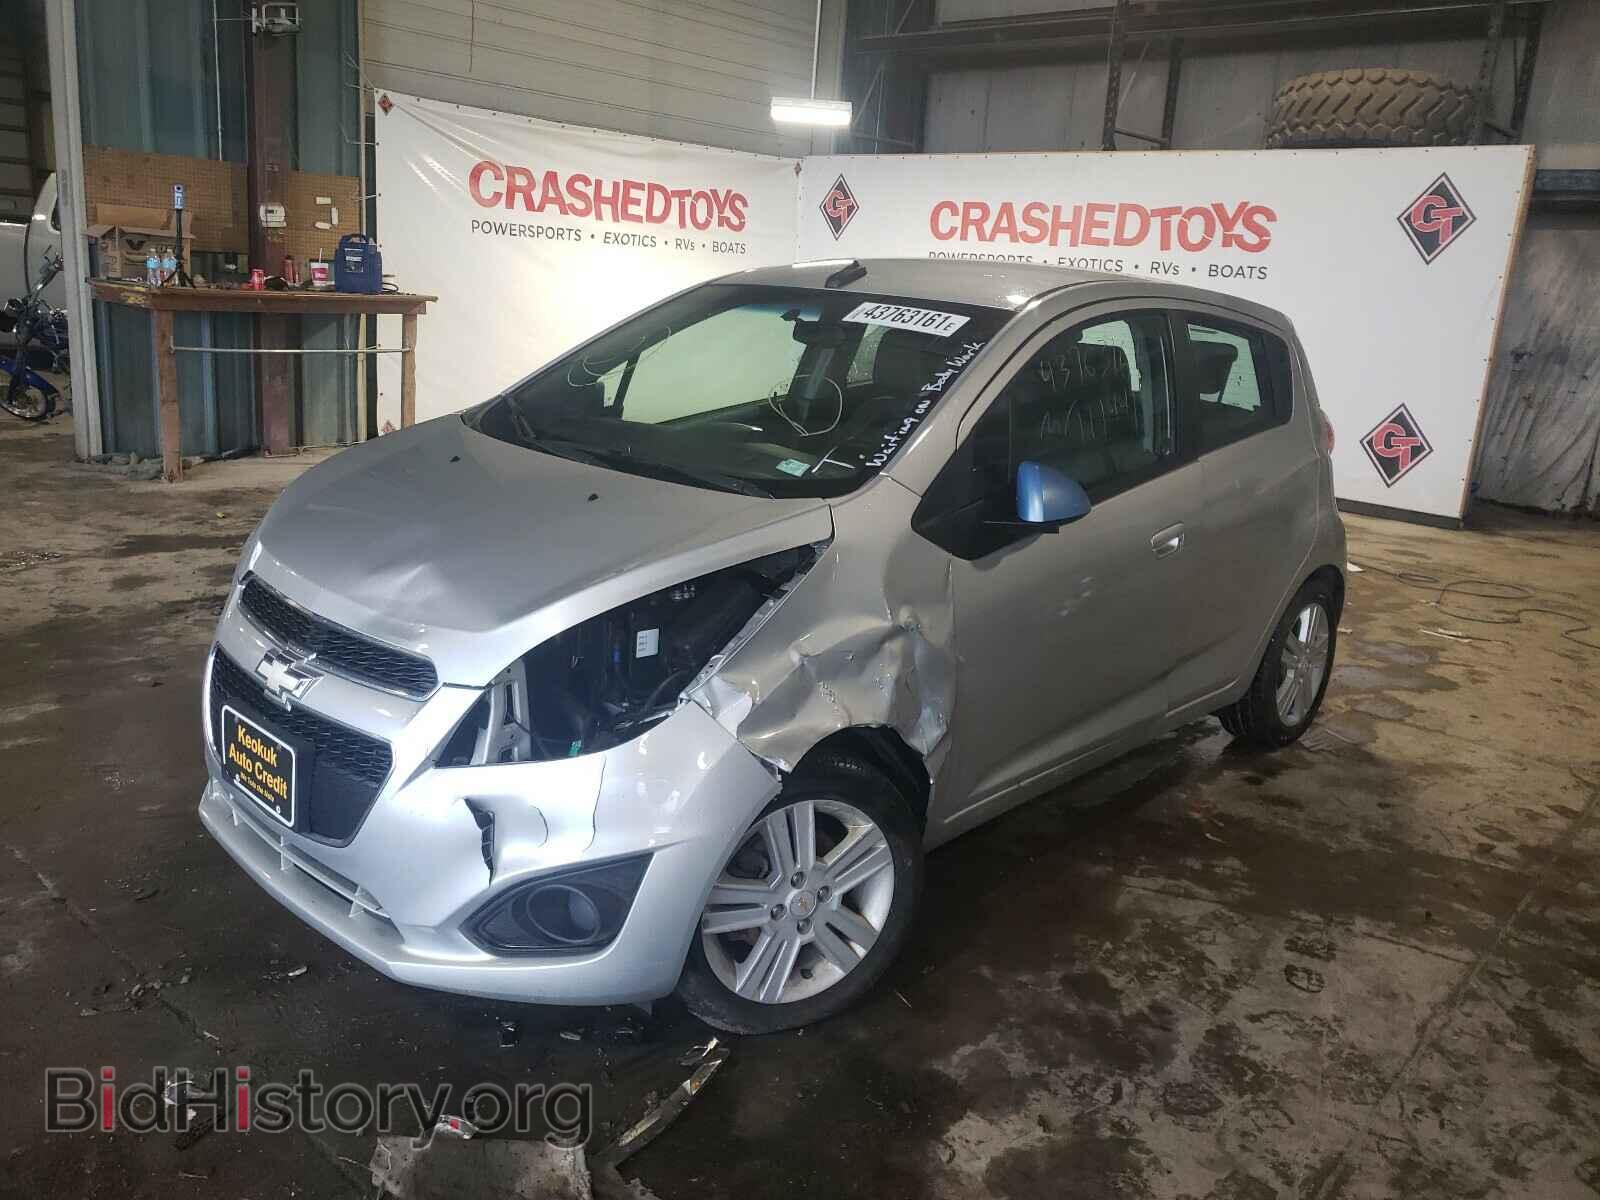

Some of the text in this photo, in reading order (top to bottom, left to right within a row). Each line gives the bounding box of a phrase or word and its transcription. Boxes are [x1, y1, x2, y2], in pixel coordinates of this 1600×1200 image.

[469, 160, 749, 233] CRASHEDTOYS
[471, 219, 747, 255] POWERSPORTS EXOTICS RVs BOATS
[929, 200, 1278, 253] CRASHEDTOYS
[1057, 256, 1124, 273] EXOTICS
[1150, 261, 1180, 276] RVs
[1208, 264, 1268, 281] BOATS
[238, 725, 276, 767] Keokuk
[229, 744, 287, 800] Auto Credit
